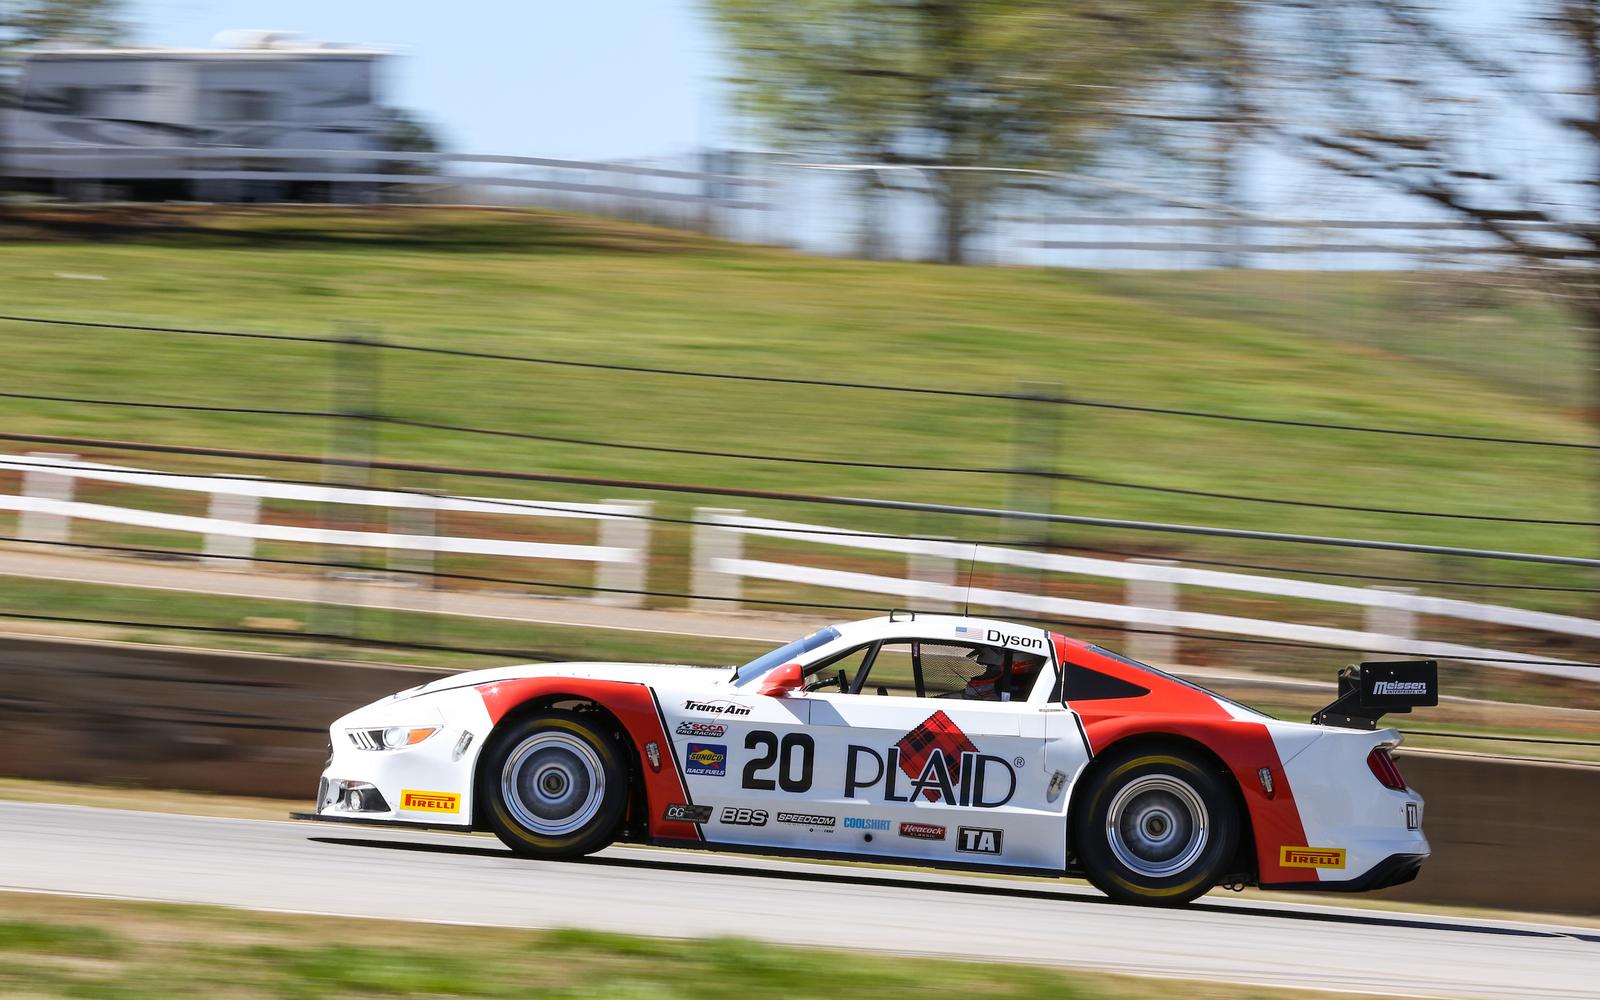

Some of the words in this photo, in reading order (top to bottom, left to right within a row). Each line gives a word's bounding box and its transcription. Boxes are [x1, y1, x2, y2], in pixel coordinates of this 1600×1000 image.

[987, 629, 1042, 648] Dyson
[1373, 681, 1426, 695] Meissen
[684, 700, 724, 714] Trans
[724, 705, 751, 716] Am
[691, 723, 724, 732] SCCA
[690, 752, 723, 761] SUNOCO
[742, 729, 815, 794] 20
[405, 794, 455, 809] PIRELLI
[668, 807, 685, 817] CG
[720, 807, 769, 826] BBS
[778, 813, 835, 826] SPEEDCOM
[843, 817, 891, 831] COOLSHIRT
[904, 824, 944, 835] Heacock
[963, 830, 996, 852] TA
[1285, 851, 1340, 864] PIRELLI
